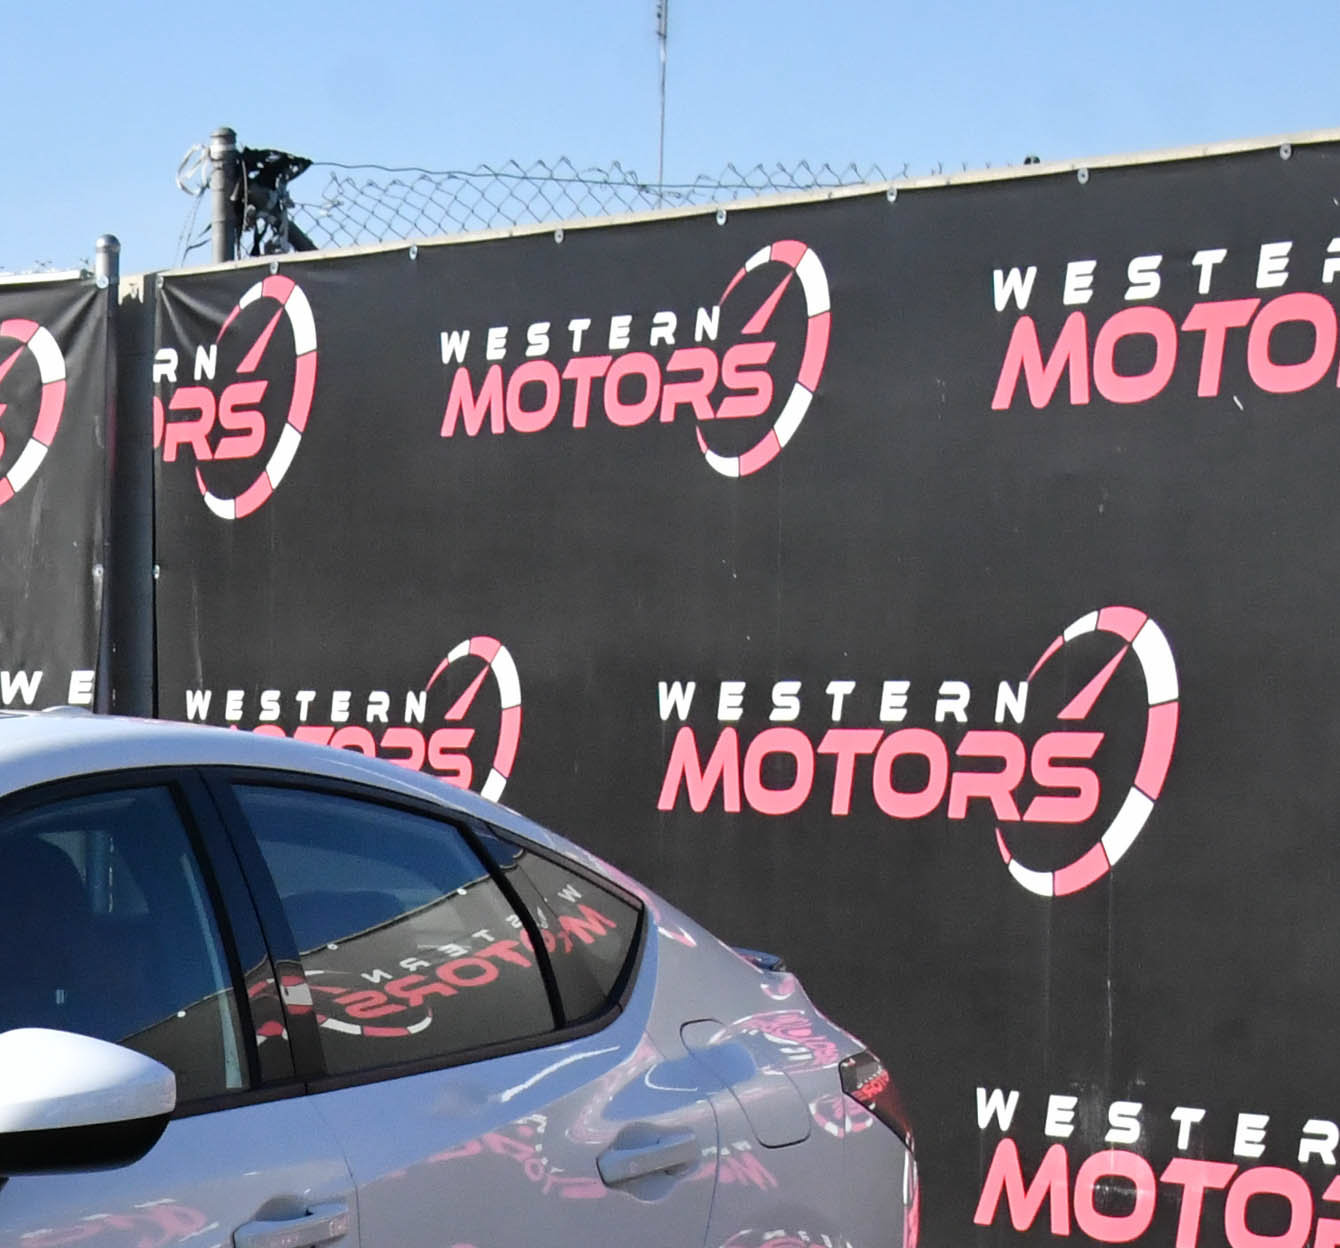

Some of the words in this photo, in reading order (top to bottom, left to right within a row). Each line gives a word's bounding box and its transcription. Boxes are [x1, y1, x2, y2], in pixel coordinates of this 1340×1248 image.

[440, 305, 721, 363] WESTERN
[991, 291, 1340, 410] MOTO
[153, 380, 269, 462] RS
[440, 341, 776, 438] MOTORS
[185, 689, 427, 723] WESTERN
[658, 680, 1027, 724] WESTERN
[657, 726, 1106, 825] MOTORS
